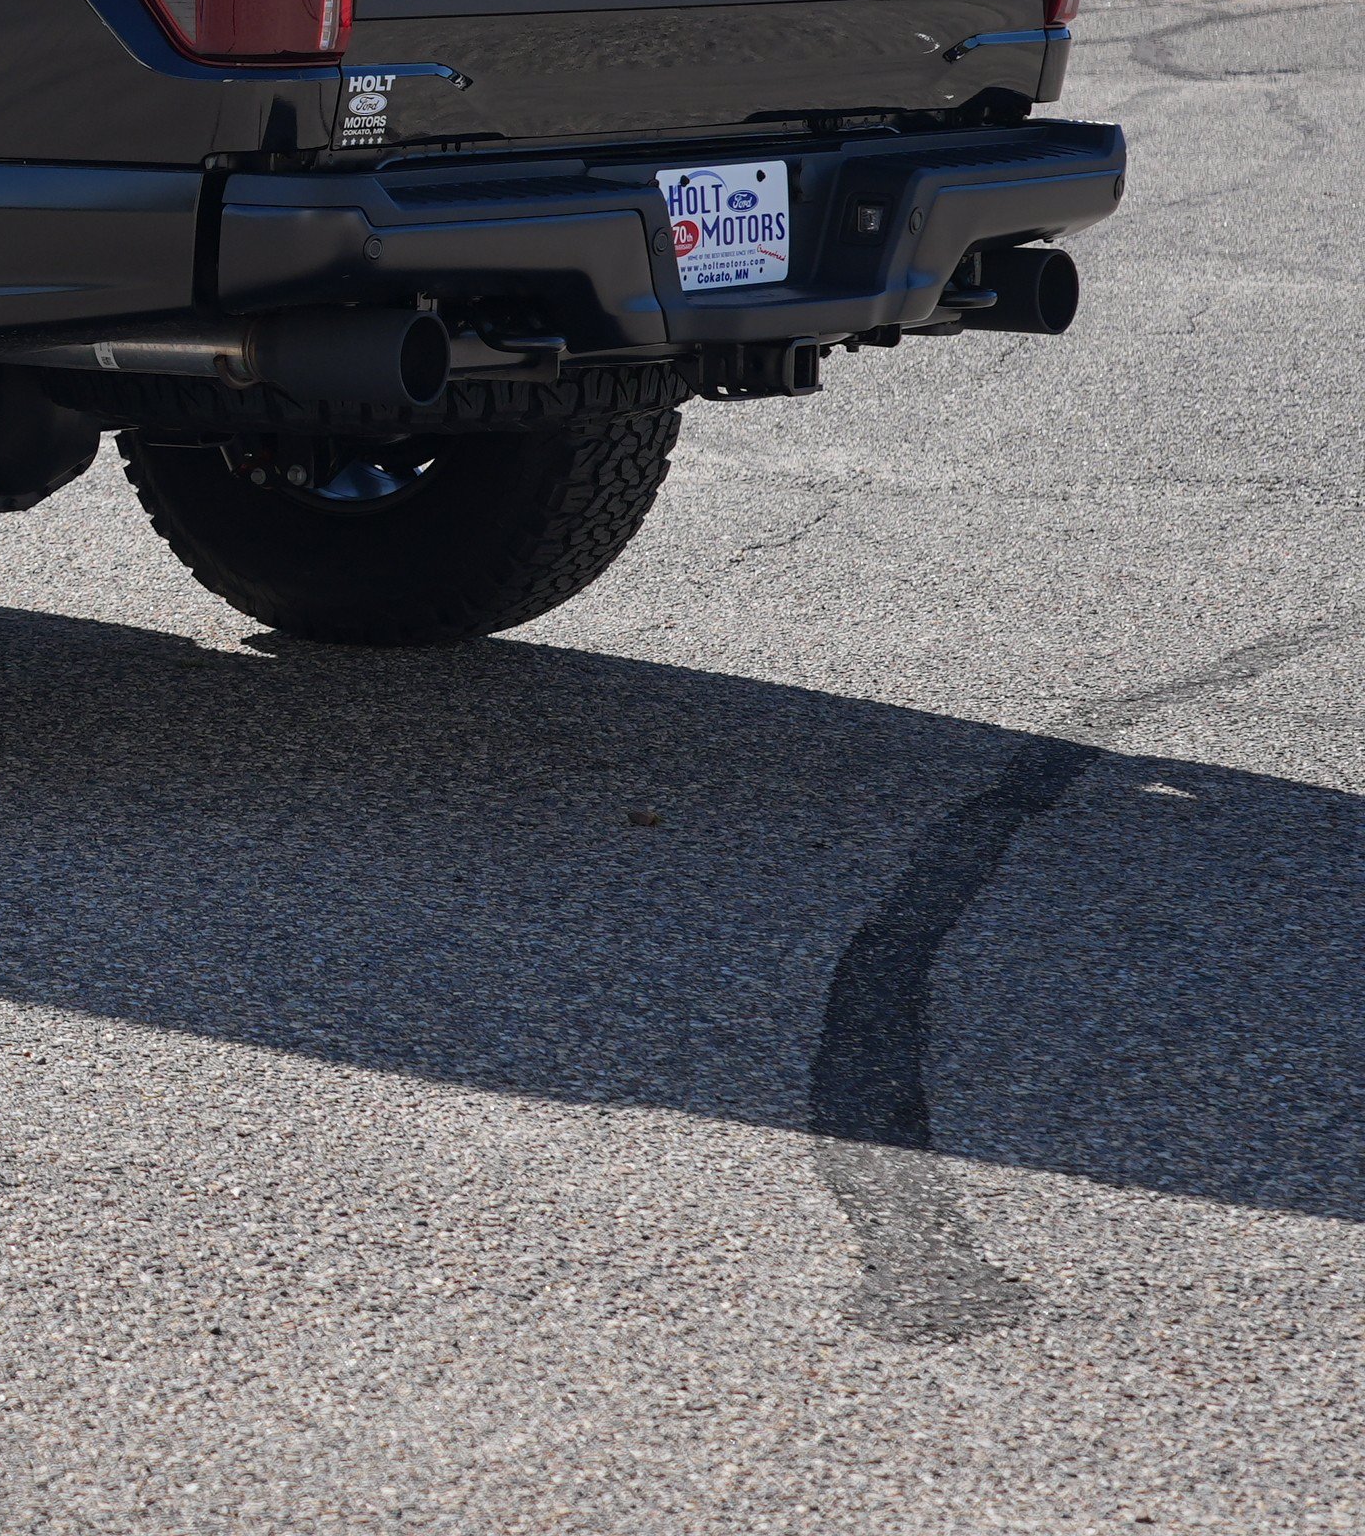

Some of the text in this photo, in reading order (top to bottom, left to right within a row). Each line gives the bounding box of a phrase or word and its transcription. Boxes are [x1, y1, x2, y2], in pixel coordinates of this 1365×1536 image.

[349, 75, 396, 92] HOLT
[356, 96, 380, 111] Ford
[343, 115, 387, 129] MOTORS
[342, 127, 385, 137] COKATO, MN
[669, 184, 723, 216] HOLT
[732, 192, 754, 209] Ford
[672, 212, 786, 248] 70th MOTORS
[680, 258, 766, 273] www.holtmotors.com
[697, 268, 749, 284] Cokato, MN
